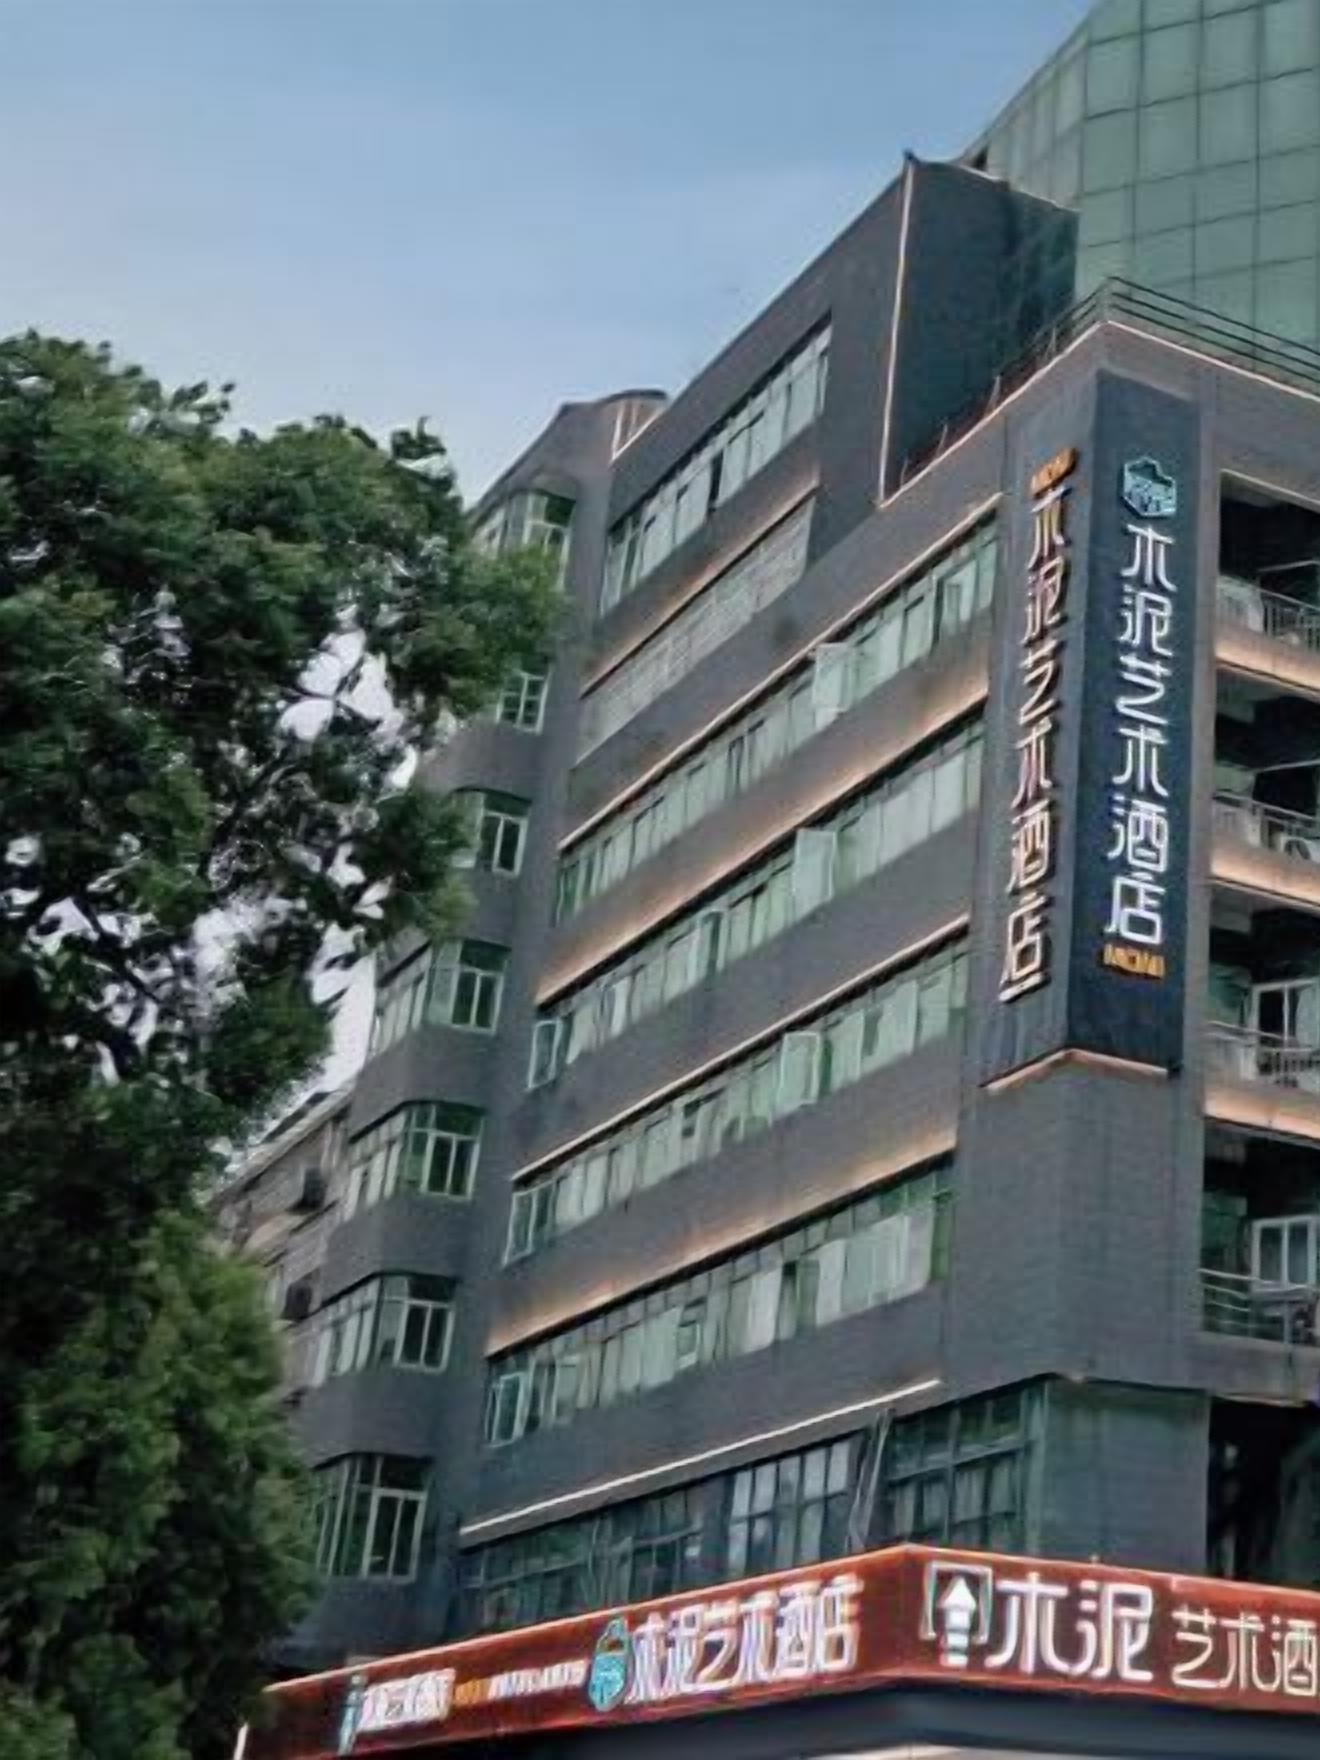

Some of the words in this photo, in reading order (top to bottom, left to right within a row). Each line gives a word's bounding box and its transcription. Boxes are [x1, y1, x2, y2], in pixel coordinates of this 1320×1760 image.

[1000, 485, 1071, 1002] 木泥艺术酒店
[1104, 523, 1177, 944] 木泥艺术酒店
[624, 1573, 864, 1704] 木泥艺术酒店
